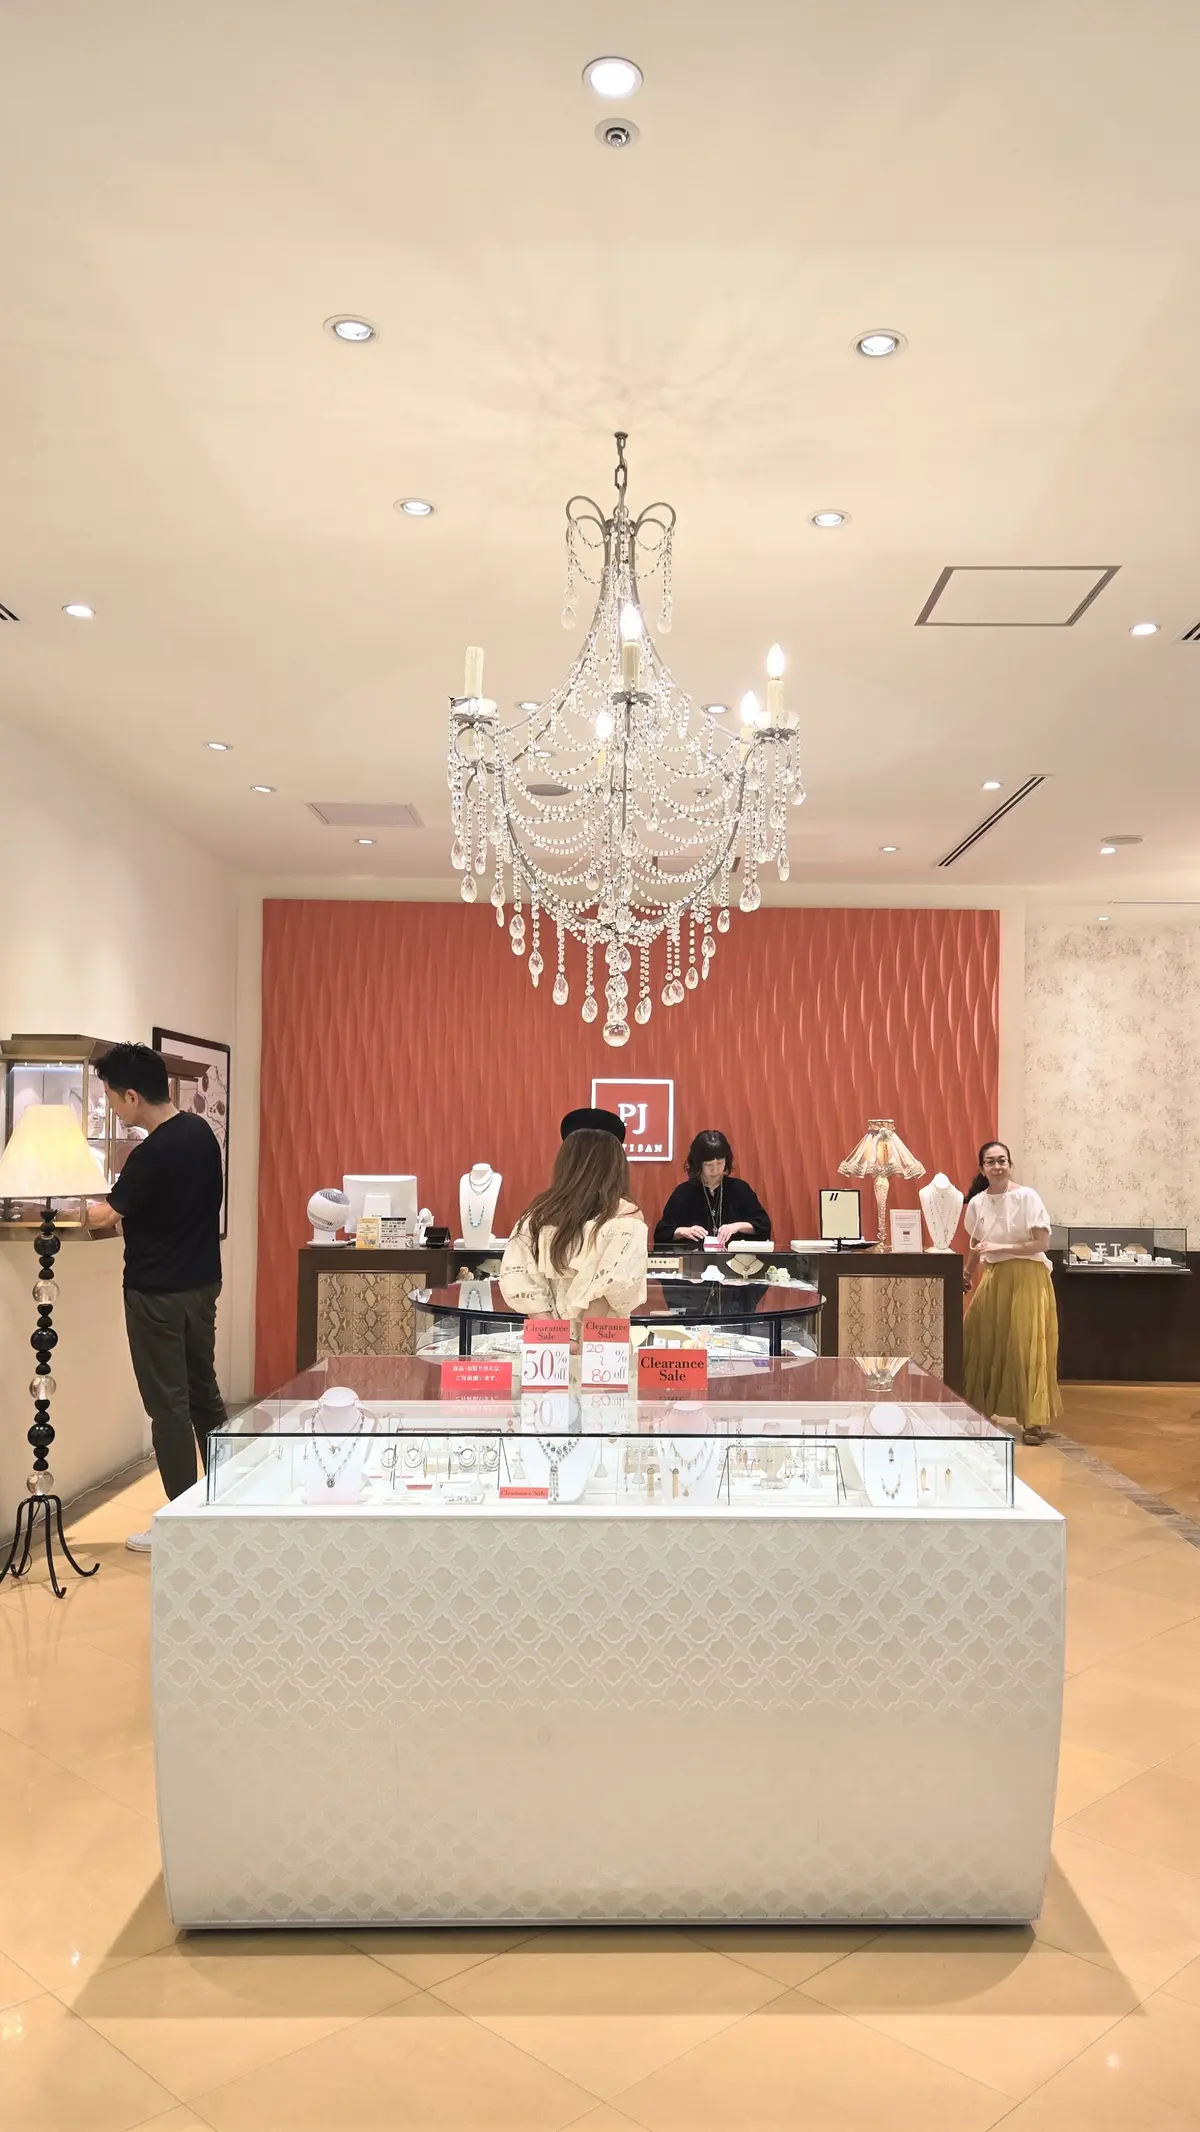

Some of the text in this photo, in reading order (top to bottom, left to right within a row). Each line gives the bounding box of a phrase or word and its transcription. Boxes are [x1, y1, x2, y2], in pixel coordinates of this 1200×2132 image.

[617, 1103, 648, 1135] PJ
[621, 1143, 663, 1153] TISAN
[525, 1324, 569, 1333] Clearance
[585, 1321, 628, 1331] Clearance
[537, 1332, 556, 1341] Sale
[597, 1330, 616, 1339] Sale
[586, 1343, 604, 1353] 20
[640, 1356, 705, 1369] Clearance
[554, 1368, 568, 1381] off
[591, 1368, 612, 1383] 80
[613, 1367, 626, 1380] off
[659, 1369, 687, 1382] Sale
